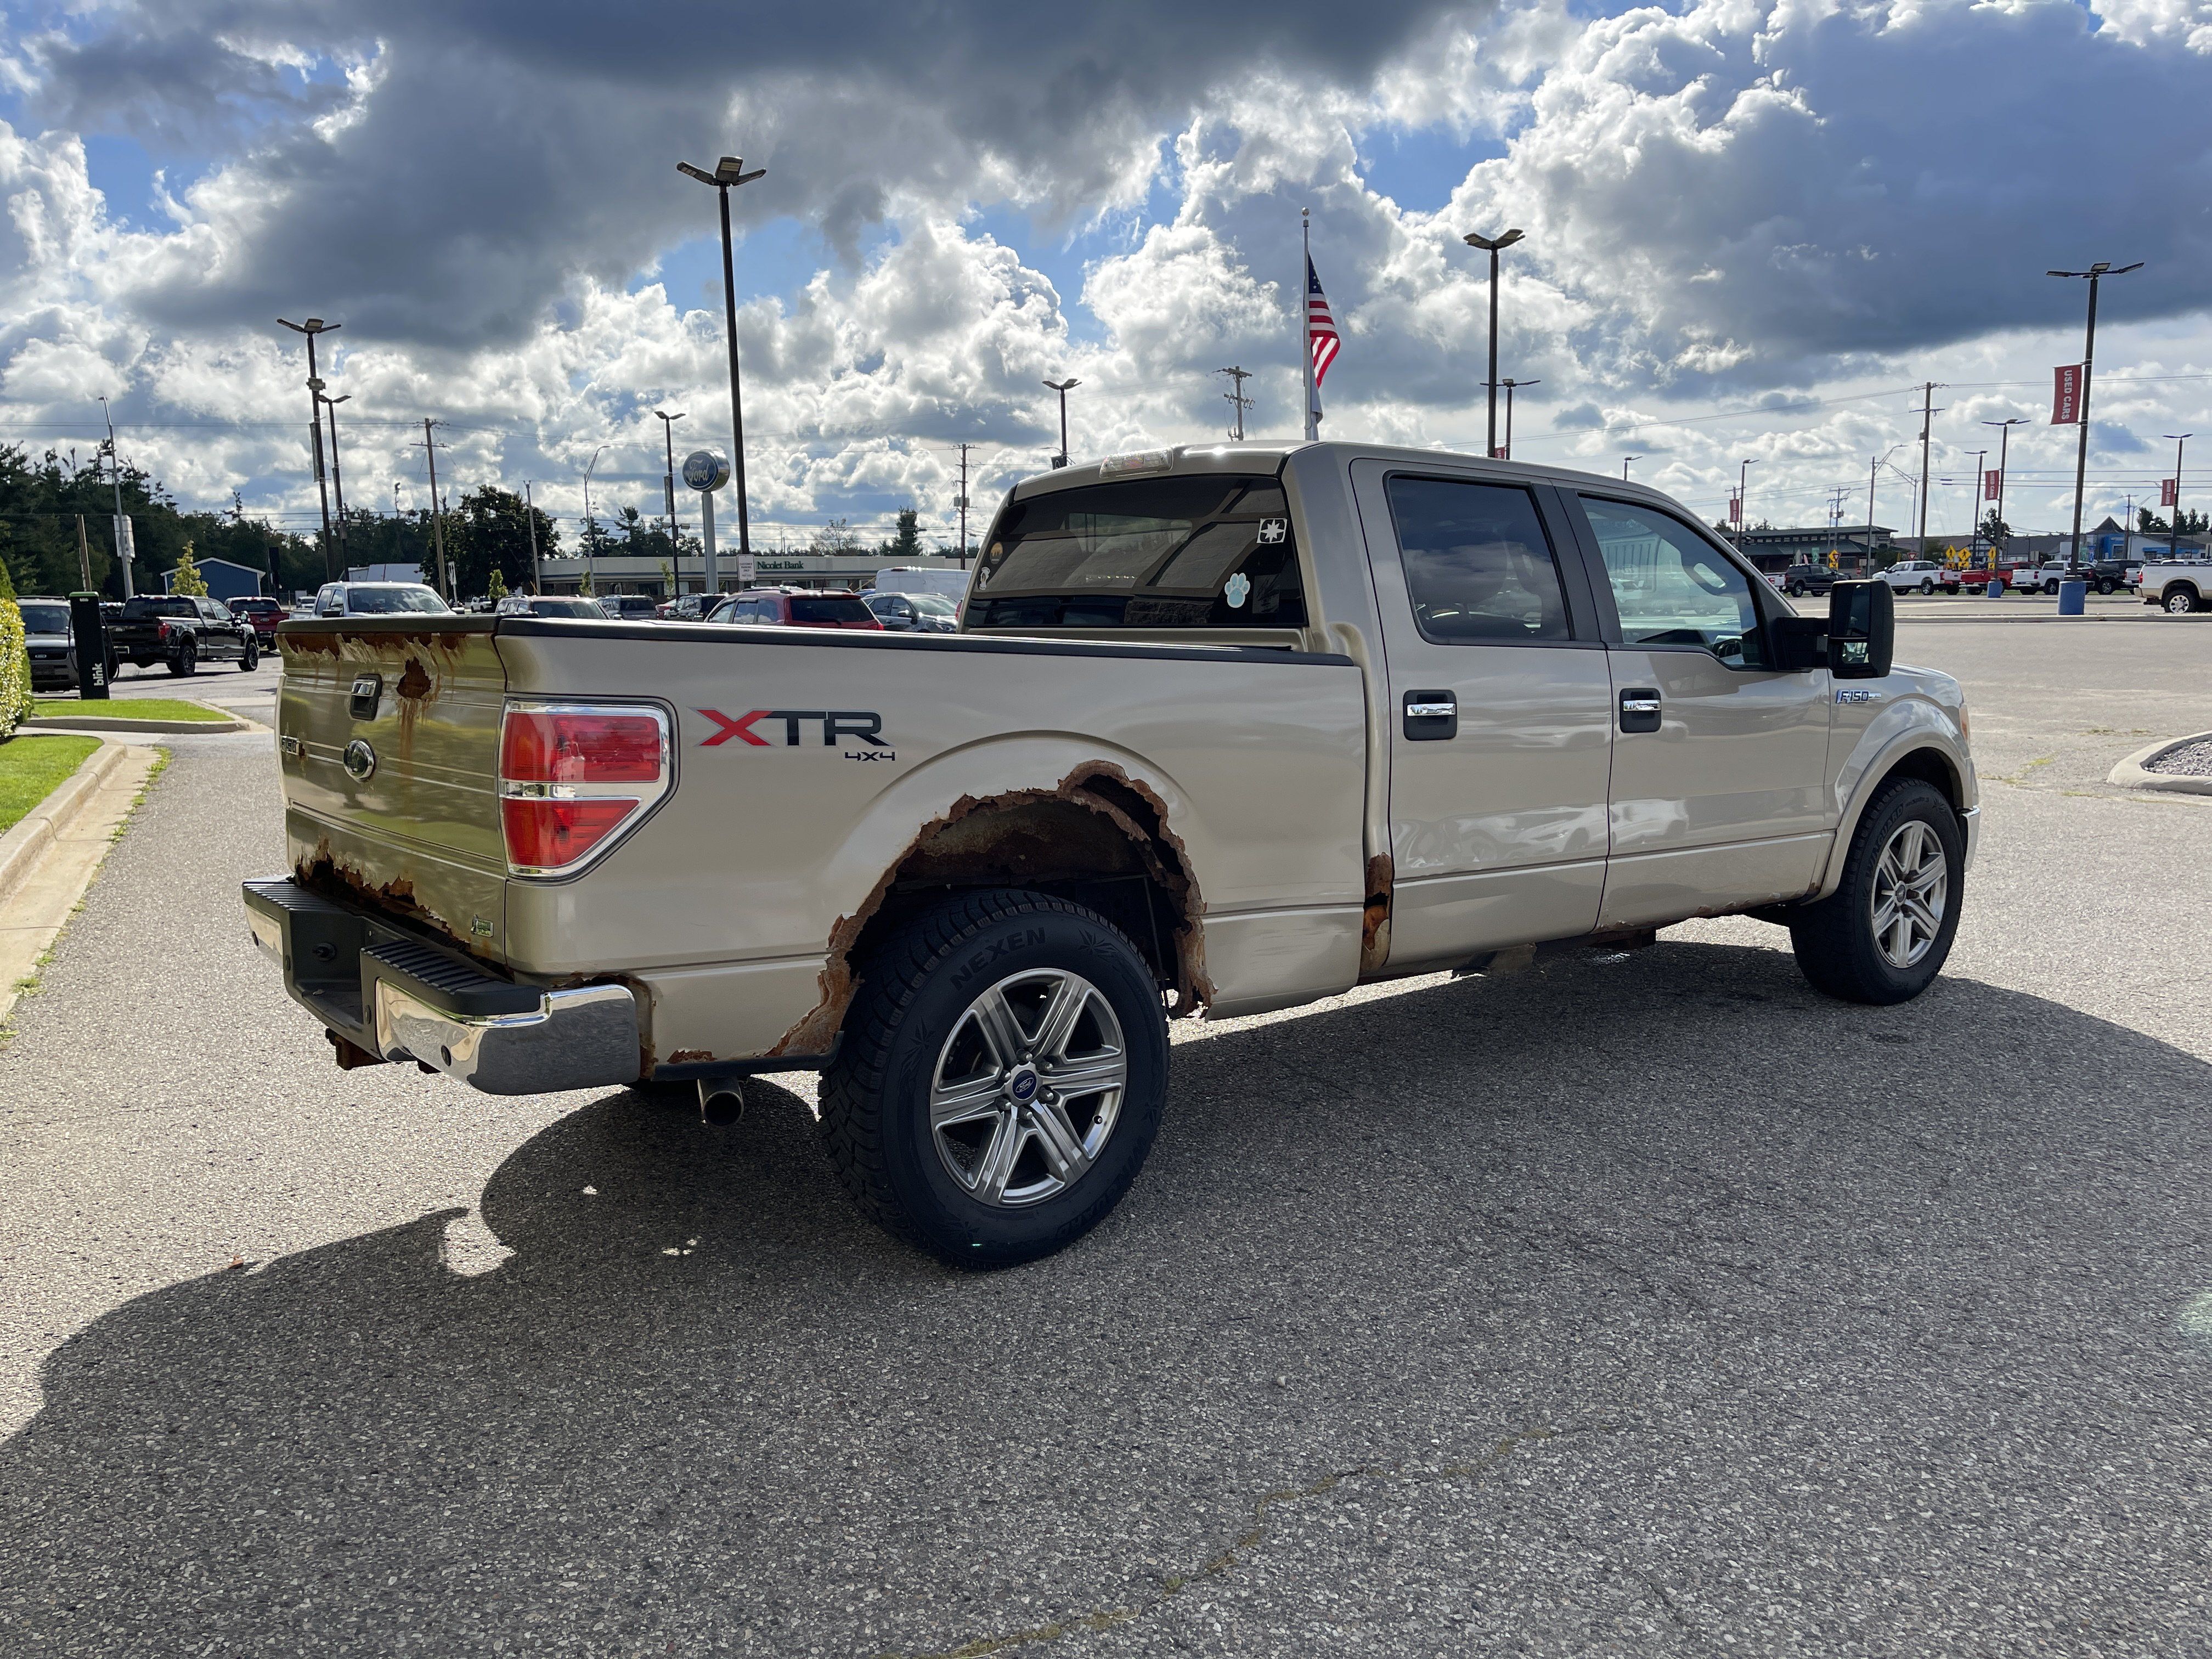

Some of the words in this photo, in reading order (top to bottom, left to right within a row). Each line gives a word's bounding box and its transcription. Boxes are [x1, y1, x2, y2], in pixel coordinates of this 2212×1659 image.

[2064, 370, 2073, 394] USED
[2061, 396, 2072, 420] CARS
[688, 459, 709, 482] Ford
[757, 561, 782, 569] Nicolet
[785, 561, 804, 569] Bank
[92, 663, 104, 686] blink
[689, 707, 893, 747] XTR
[950, 927, 1046, 991] NEXEN
